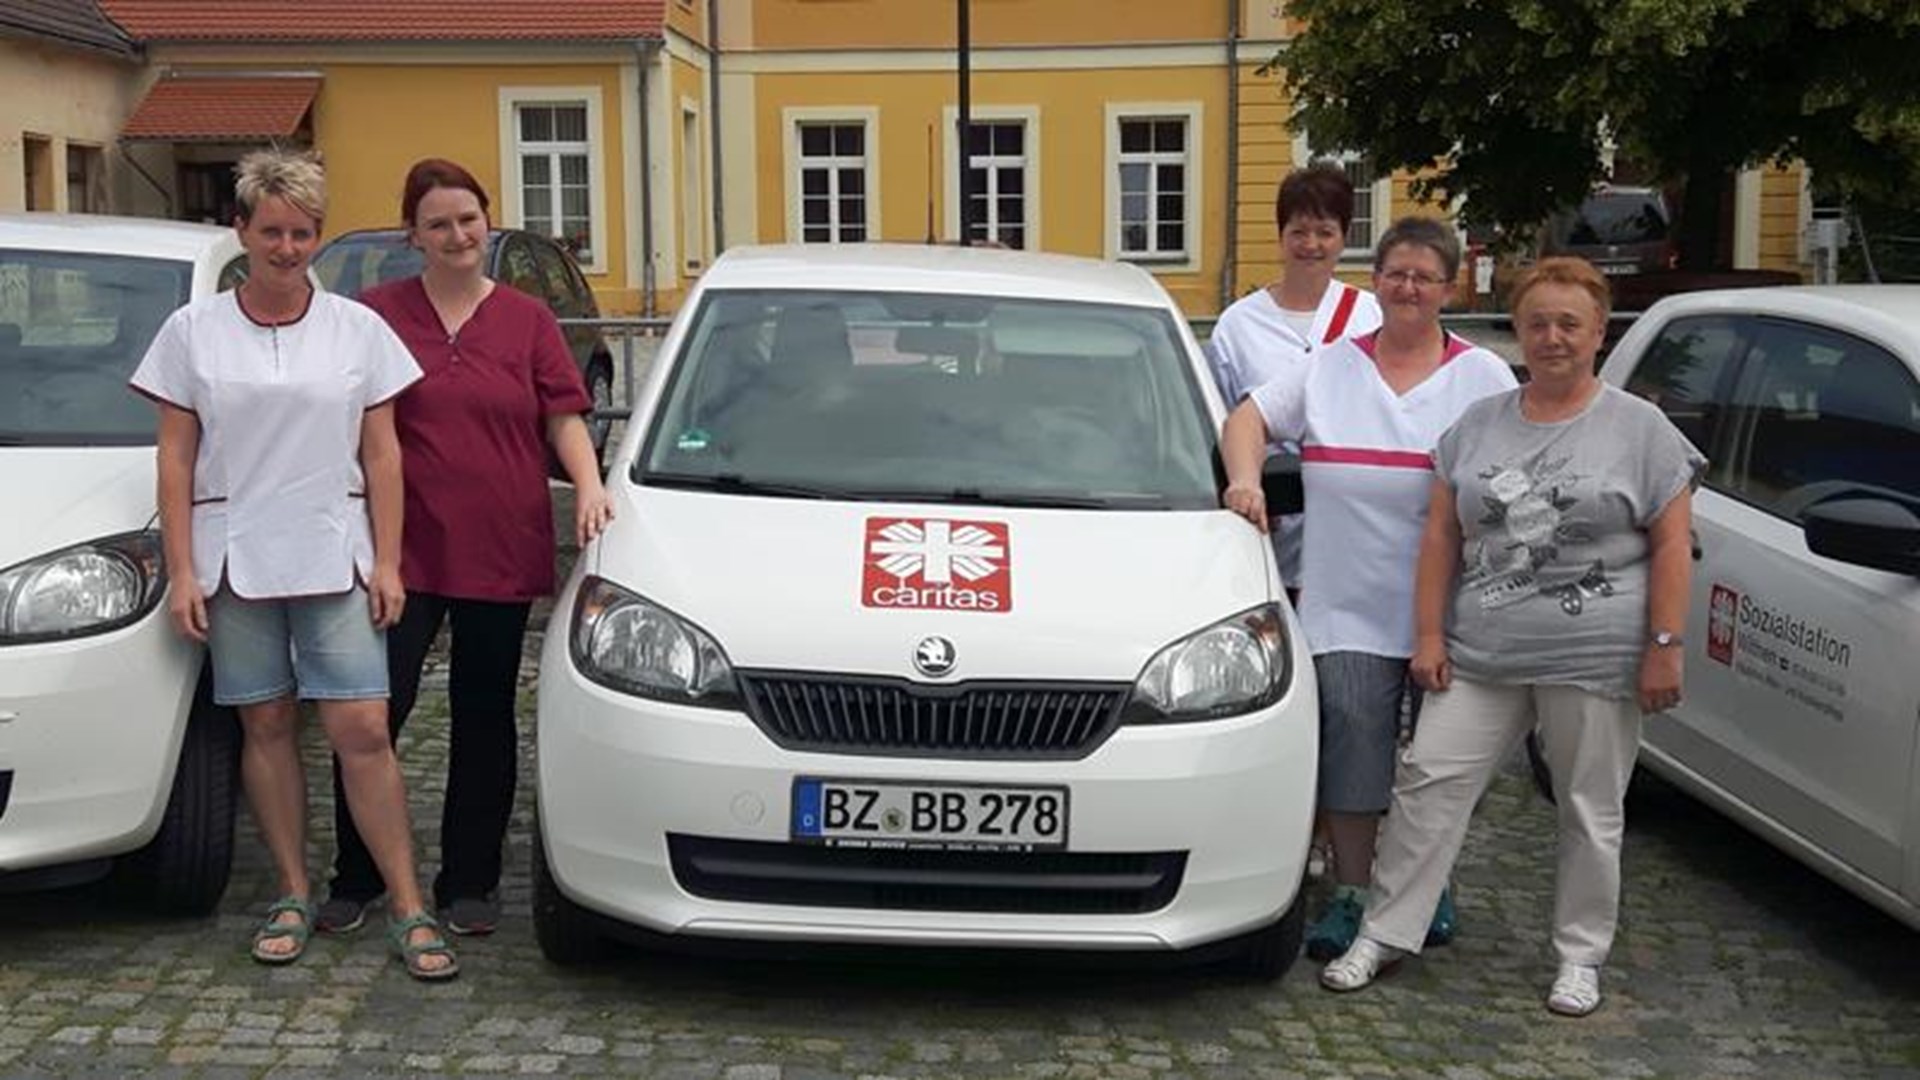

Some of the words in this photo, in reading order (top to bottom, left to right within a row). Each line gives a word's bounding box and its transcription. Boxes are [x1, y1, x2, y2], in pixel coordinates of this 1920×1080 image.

[872, 581, 999, 609] caritas
[1740, 594, 1850, 668] Sozialstation
[823, 788, 880, 831] BZ
[911, 792, 968, 833] BB
[977, 794, 1058, 836] 278
